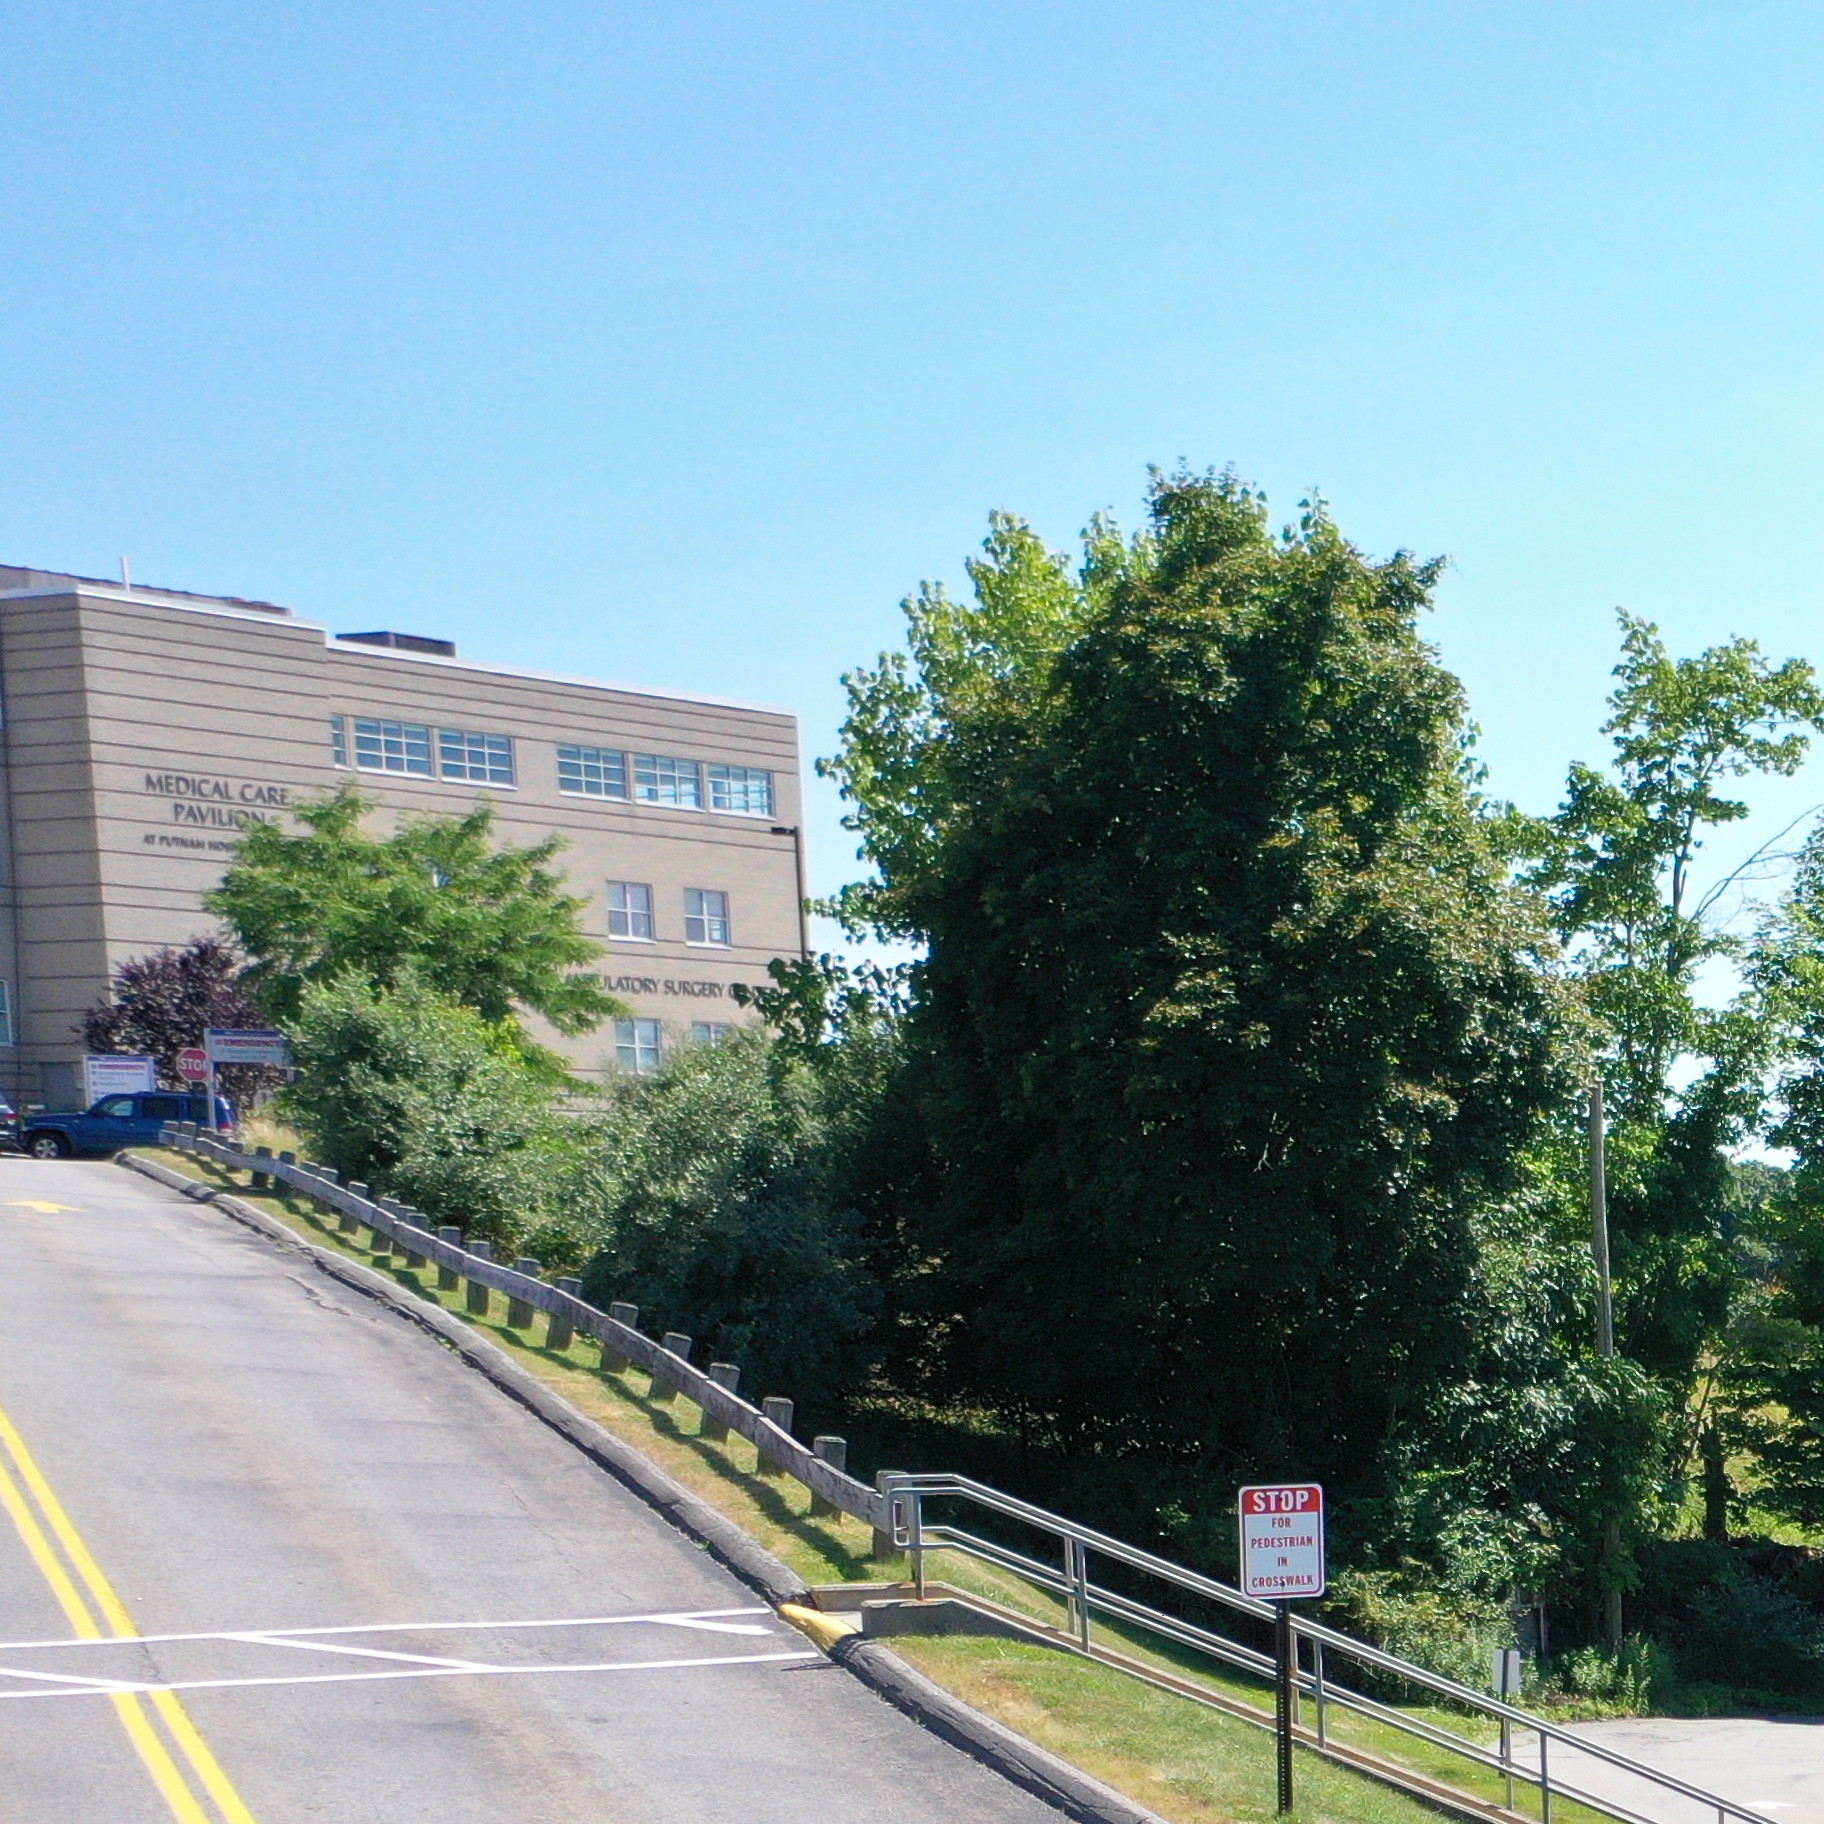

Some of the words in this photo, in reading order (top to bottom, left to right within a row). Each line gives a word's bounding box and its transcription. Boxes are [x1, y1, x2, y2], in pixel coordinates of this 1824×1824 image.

[145, 772, 234, 800] MEDICAL
[240, 784, 292, 806] CARE
[173, 802, 266, 831] PAVILION
[664, 979, 724, 998] SURGERY
[1253, 1490, 1310, 1512] STOP
[1271, 1517, 1291, 1529] FOR
[1251, 1536, 1313, 1549] PEDESTRIAN
[1277, 1556, 1287, 1567] IN
[1252, 1574, 1314, 1589] CROSSWALK
